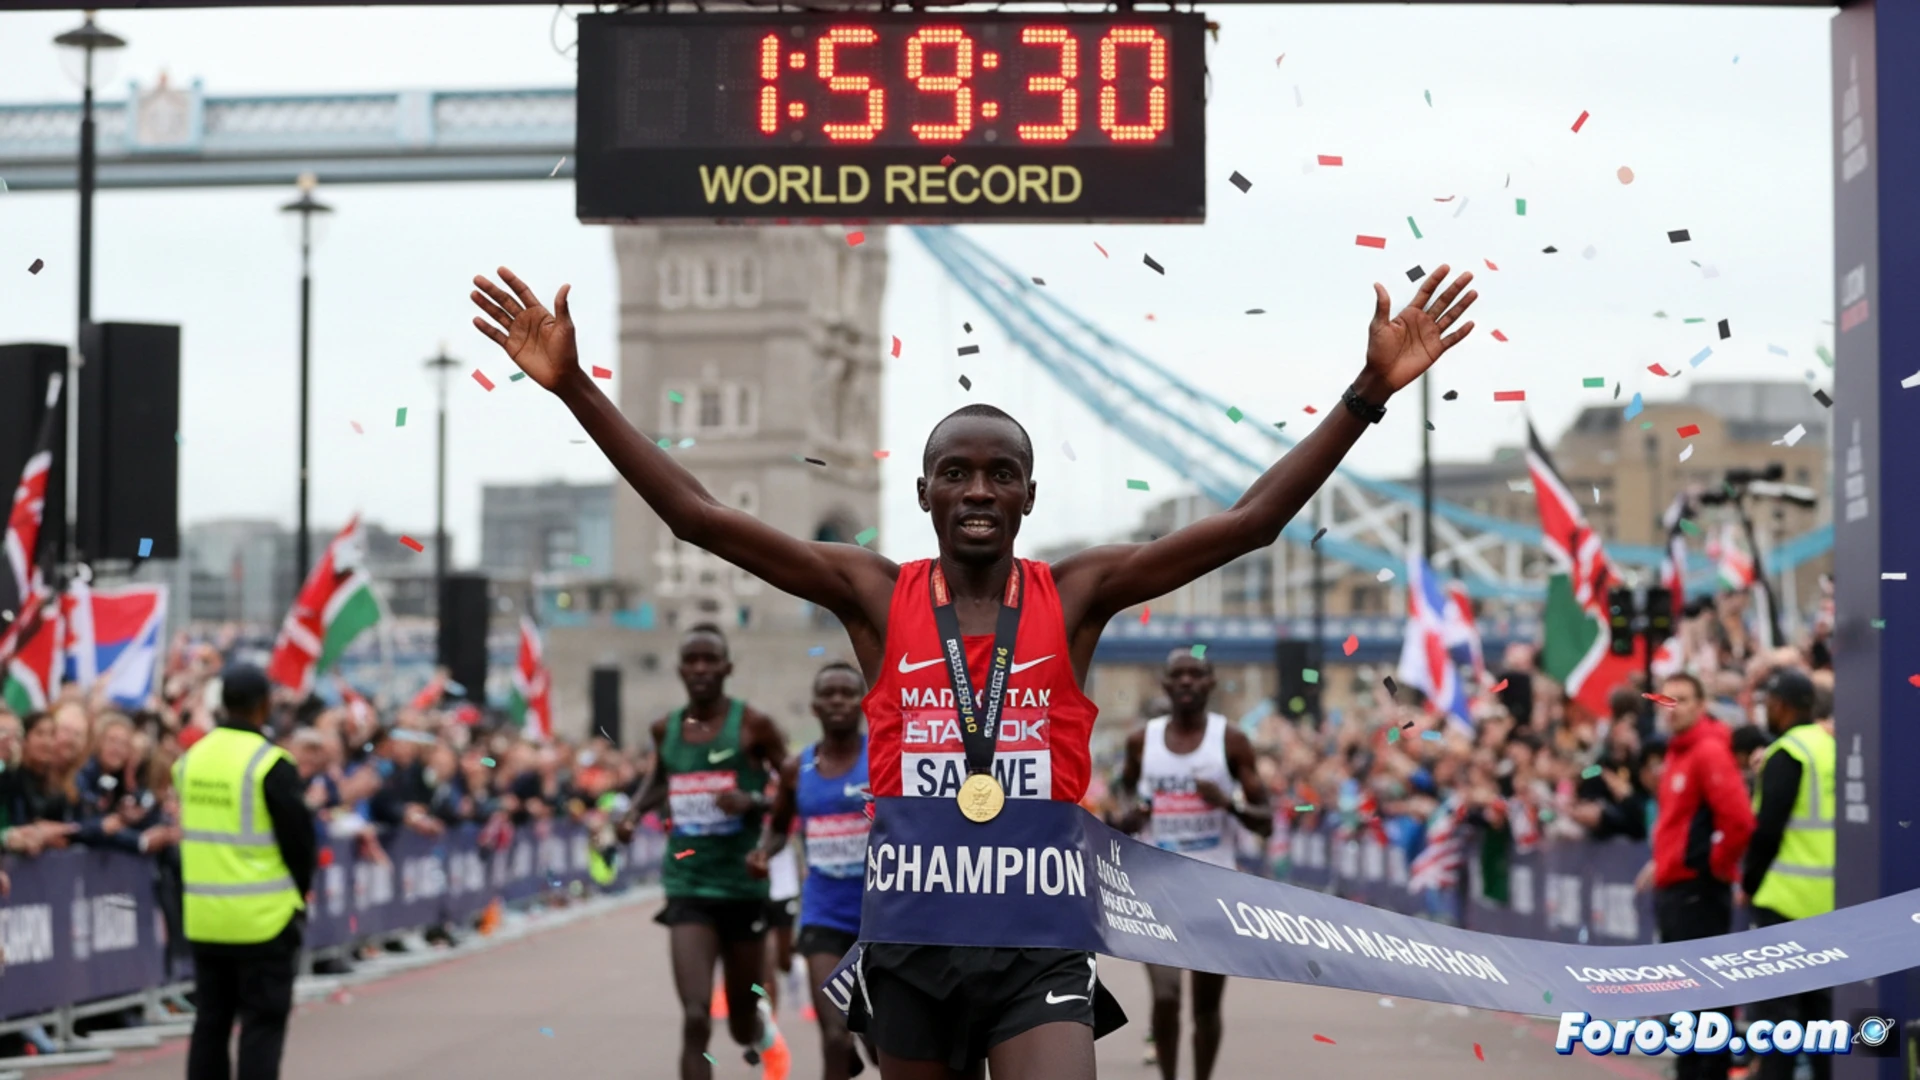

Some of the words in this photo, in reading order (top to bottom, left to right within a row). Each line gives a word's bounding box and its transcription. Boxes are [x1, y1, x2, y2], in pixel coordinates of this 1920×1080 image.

[760, 27, 1168, 142] 1:59:30
[699, 165, 870, 204] WORLD
[885, 165, 1083, 204] RECORD
[1217, 898, 1354, 954] LONDON
[1343, 924, 1510, 986] MARATHON
[1565, 964, 1686, 983] LONDON
